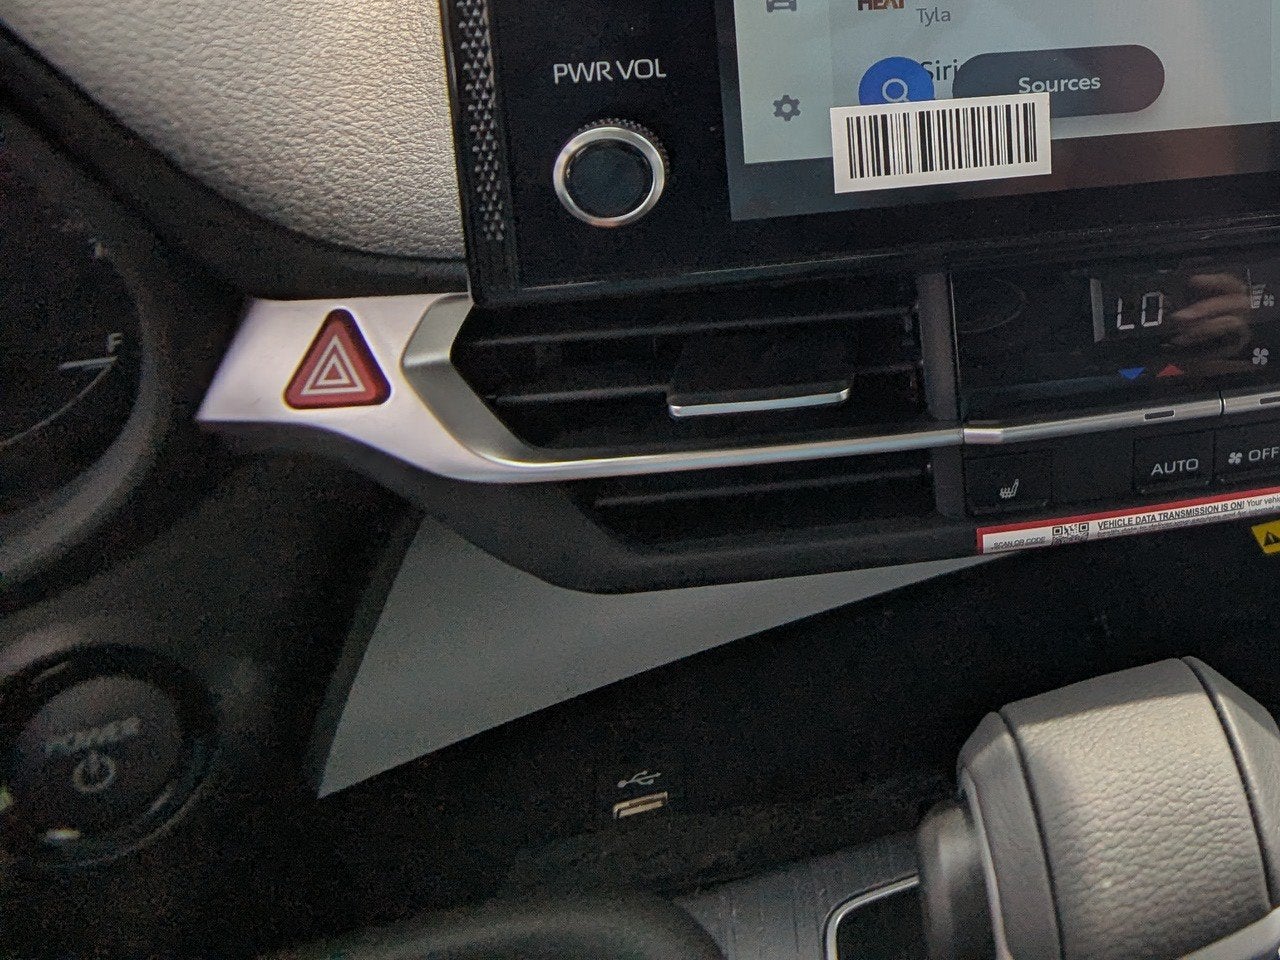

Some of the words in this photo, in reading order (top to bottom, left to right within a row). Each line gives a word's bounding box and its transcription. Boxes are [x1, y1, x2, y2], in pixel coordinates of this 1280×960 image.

[916, 7, 951, 26] Tyla
[553, 60, 614, 84] PWR
[616, 58, 667, 80] VOL
[1018, 76, 1101, 94] Sources
[1117, 291, 1165, 330] LO
[1248, 446, 1280, 463] OFF
[1151, 458, 1199, 476] AUTO
[1097, 517, 1133, 531] VEHICLE
[1135, 513, 1156, 526] DATA
[1158, 505, 1219, 521] TRANSMISSION
[1220, 503, 1229, 512] IS
[1246, 498, 1262, 507] Your
